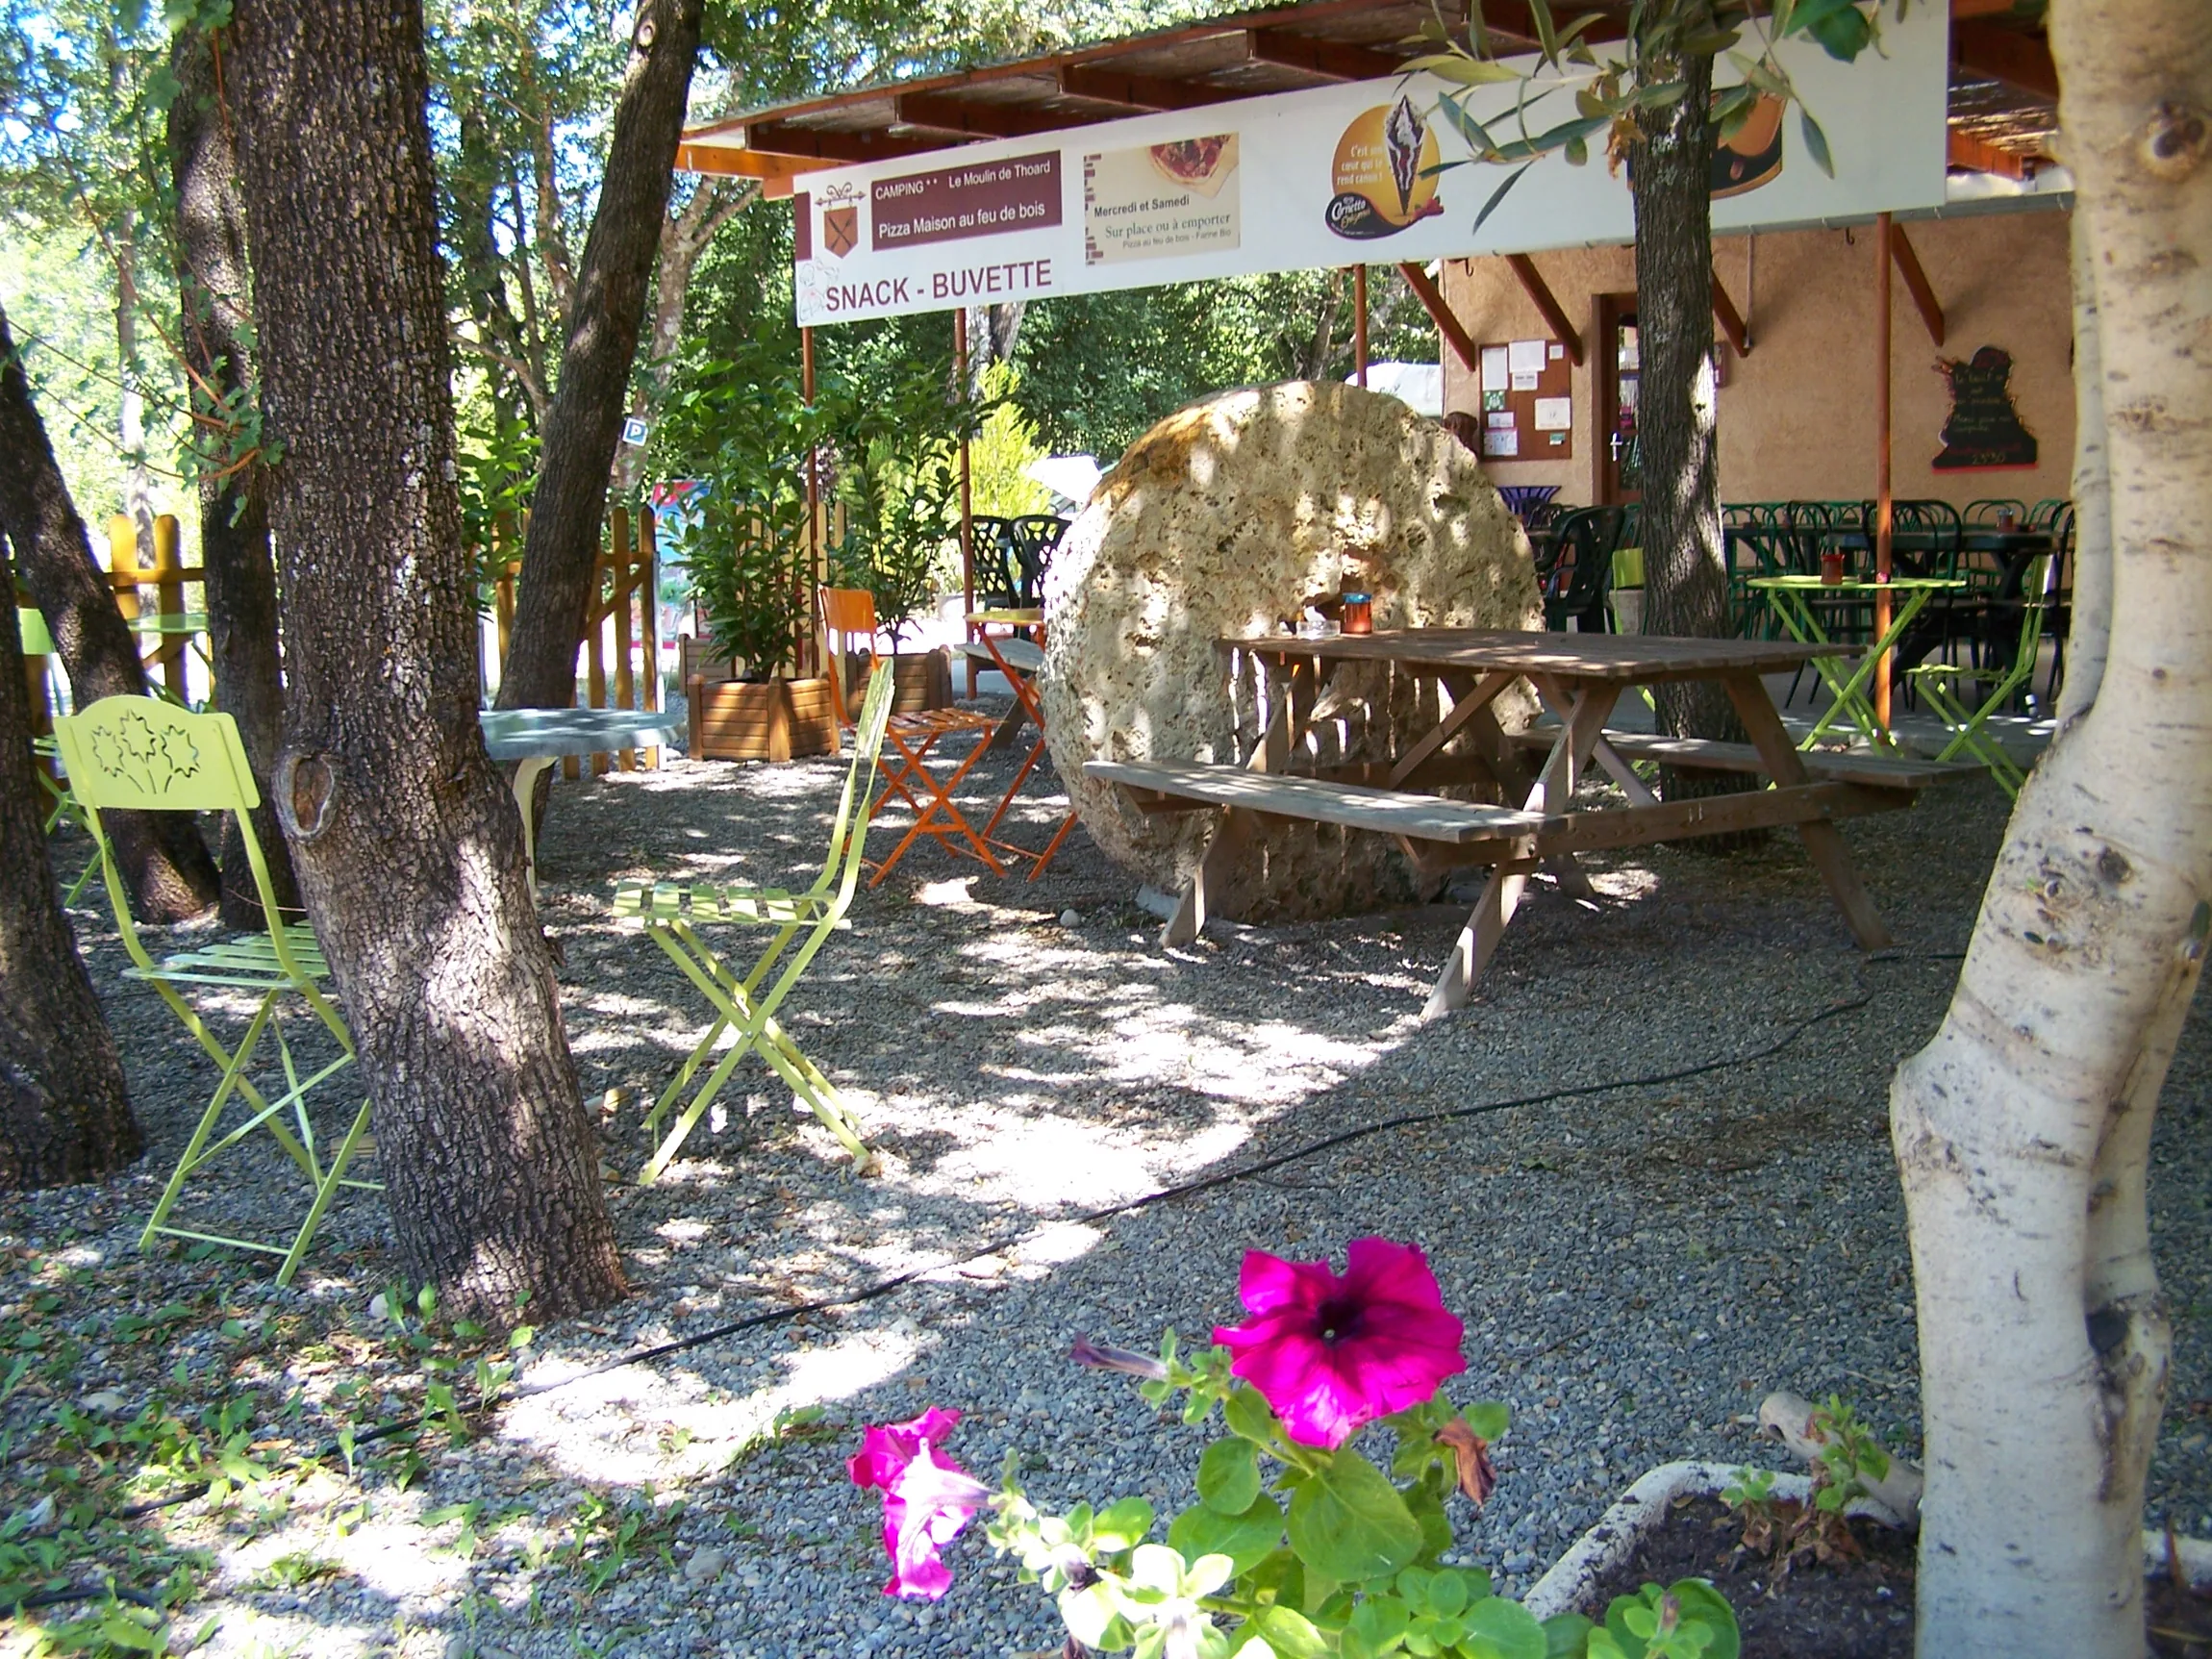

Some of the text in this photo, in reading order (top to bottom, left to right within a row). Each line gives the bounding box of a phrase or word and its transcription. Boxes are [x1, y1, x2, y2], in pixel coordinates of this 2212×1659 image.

[875, 160, 1050, 200] CAMPING Le Moulin de Thoard
[1093, 194, 1190, 217] Mercredi et Samedi
[1331, 198, 1367, 221] Cornetto
[878, 201, 1045, 239] Pizza Maison au feu de bois
[1105, 214, 1231, 239] Sur place ou à emporter
[1122, 239, 1142, 249] Pizza
[1143, 239, 1152, 247] au
[1165, 235, 1174, 244] de
[1175, 232, 1190, 242] bois
[826, 276, 910, 312] SNACK
[932, 259, 1052, 300] BUVETTE
